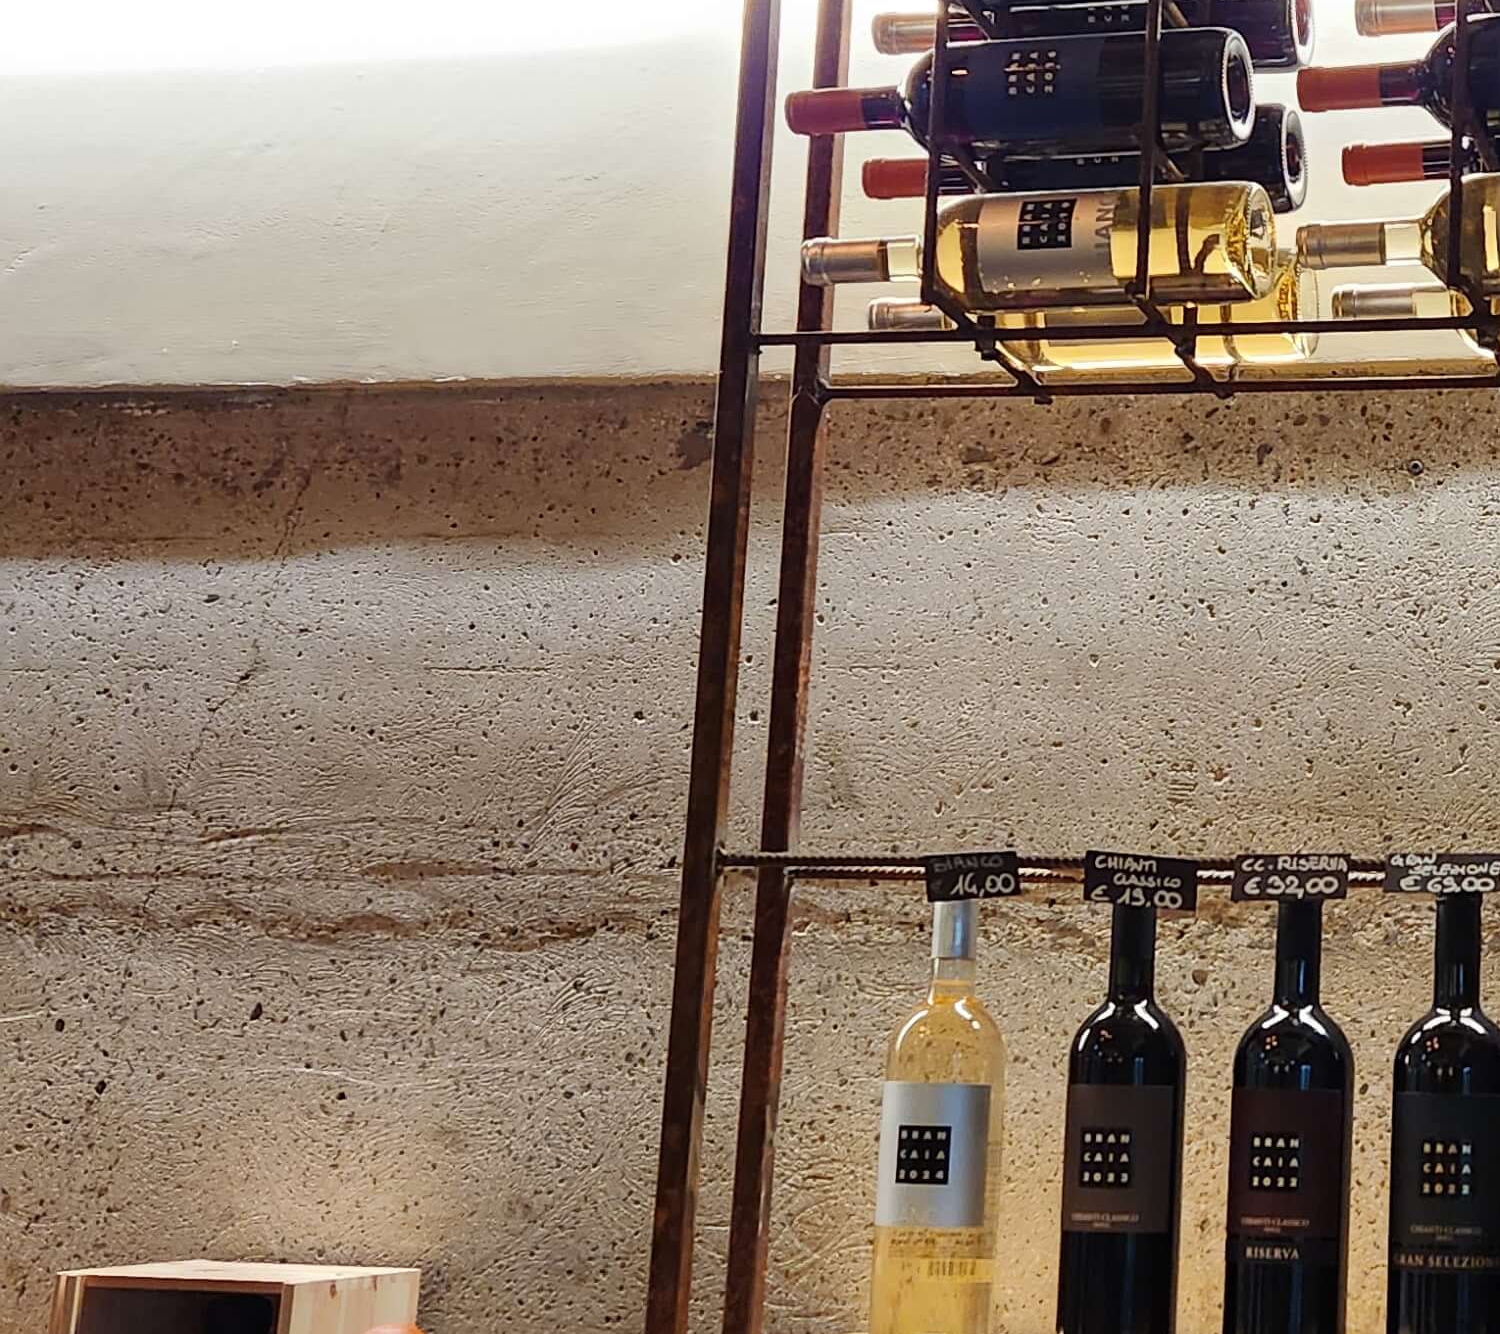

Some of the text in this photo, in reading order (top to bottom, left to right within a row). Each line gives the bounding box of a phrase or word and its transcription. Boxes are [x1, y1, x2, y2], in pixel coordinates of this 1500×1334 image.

[1008, 50, 1020, 95] BRAN
[1022, 203, 1034, 245] BRAN
[1040, 201, 1053, 244] CAIA
[1094, 855, 1158, 873] CHIANTI
[1277, 855, 1349, 873] RISERVA
[1244, 875, 1339, 900] € 32,00
[901, 1130, 948, 1141] BRAN
[1083, 1132, 1131, 1144] BRAN
[1253, 1137, 1300, 1148] BRAN
[1423, 1143, 1472, 1155] BRAN
[899, 1148, 946, 1161] CAIA
[1083, 1152, 1131, 1163] CAIA
[1252, 1156, 1300, 1168] CAIA
[1423, 1162, 1472, 1174] CAIA
[1246, 1246, 1300, 1260] RISERVA
